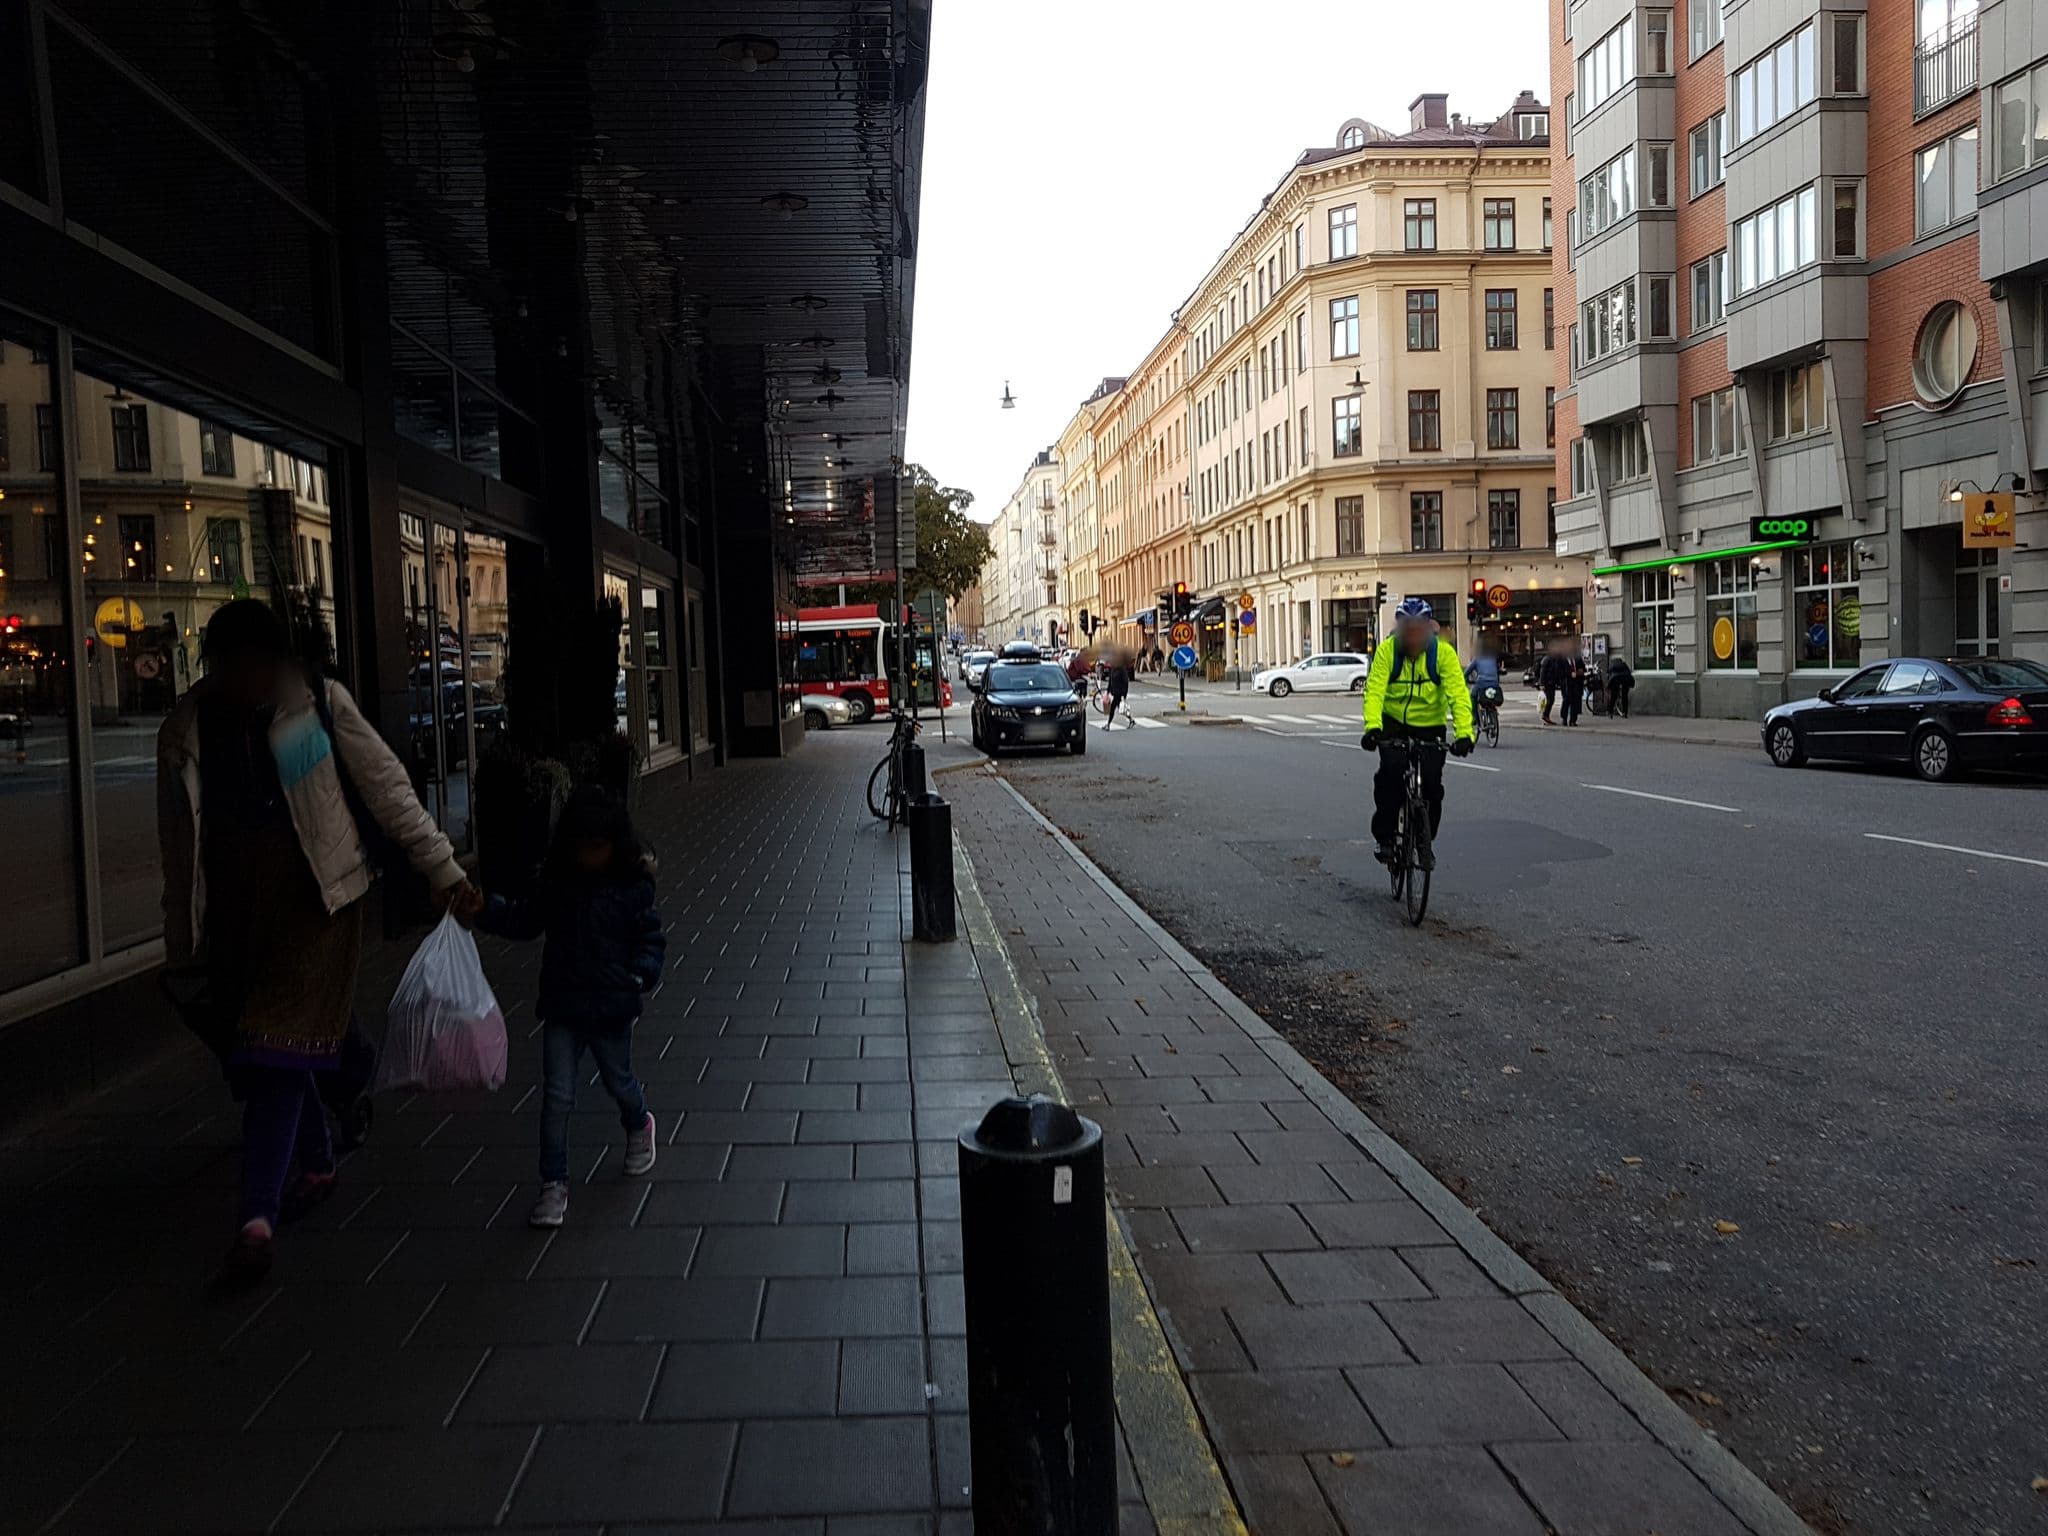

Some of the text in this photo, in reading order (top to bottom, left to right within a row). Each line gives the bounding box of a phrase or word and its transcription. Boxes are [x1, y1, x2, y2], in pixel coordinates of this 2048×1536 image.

[1759, 519, 1808, 537] coop
[1491, 590, 1507, 603] 40
[1174, 627, 1190, 640] 40
